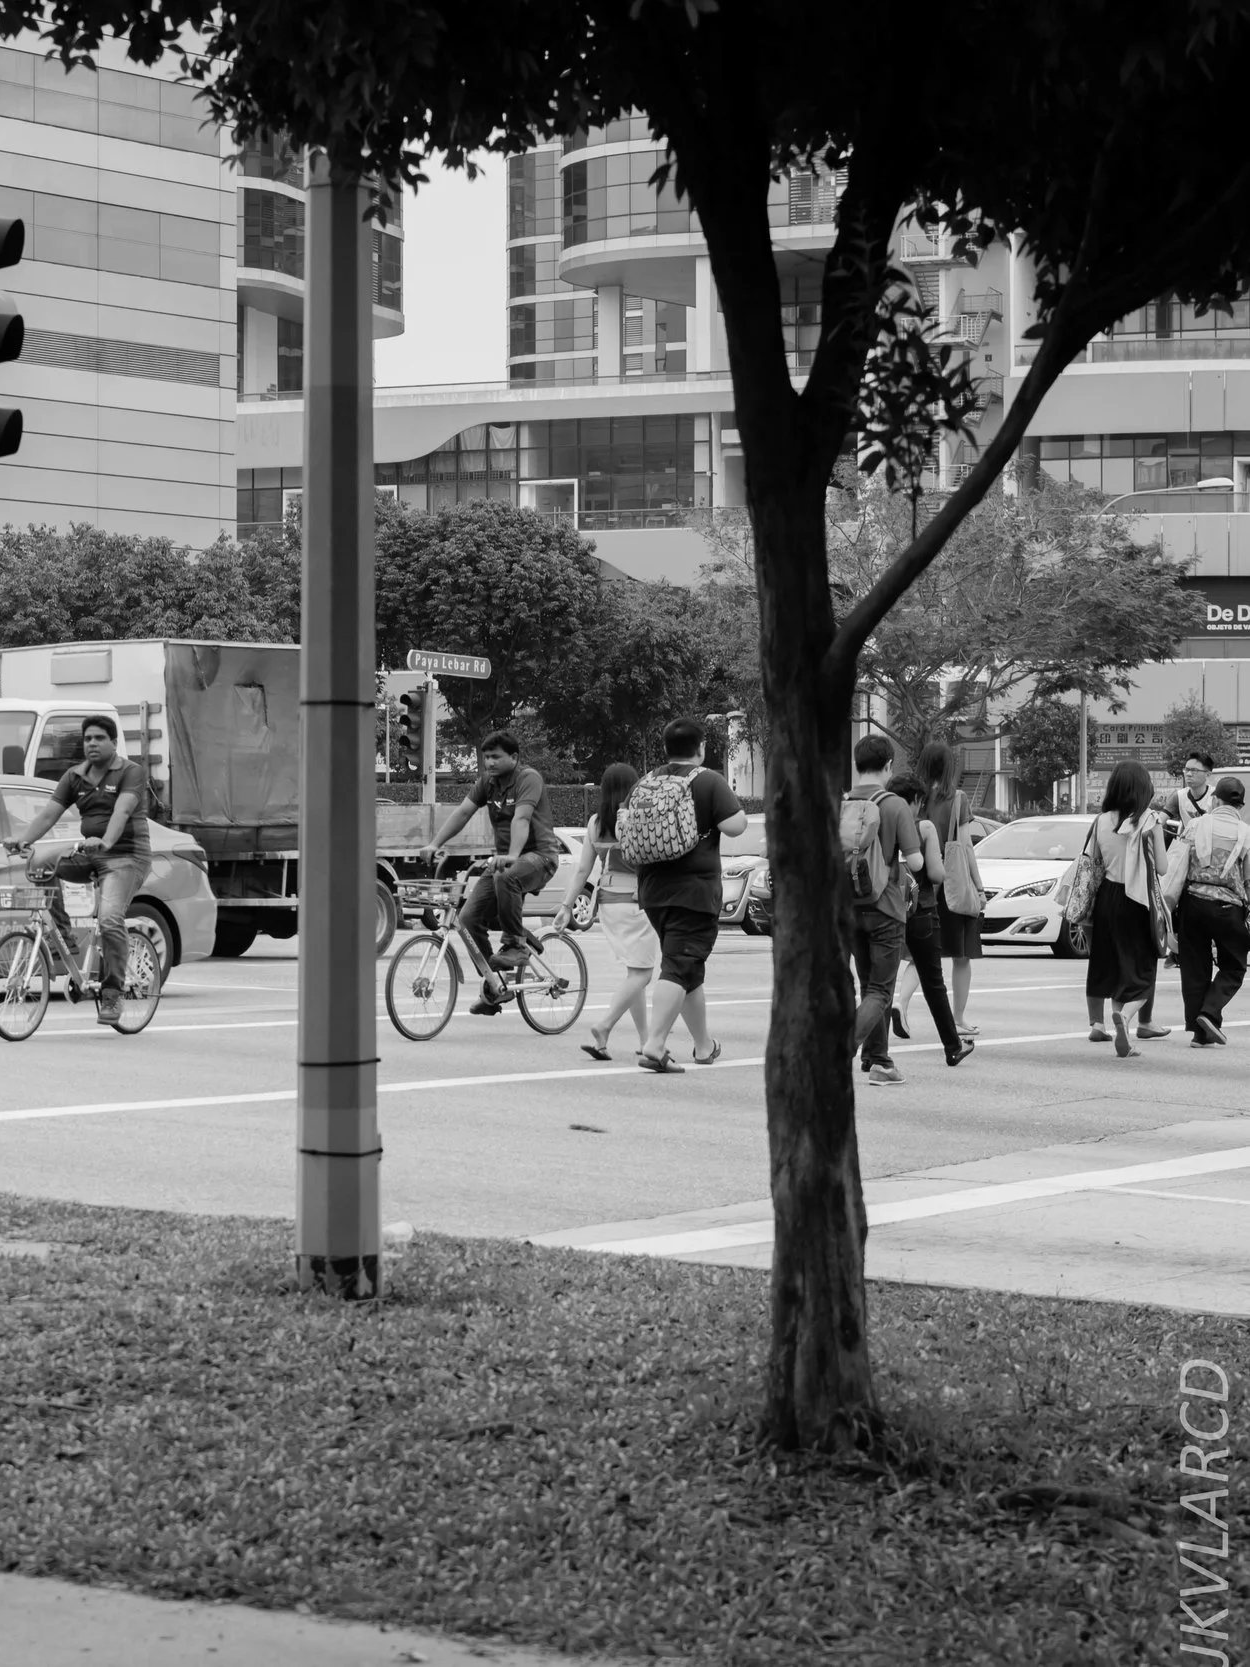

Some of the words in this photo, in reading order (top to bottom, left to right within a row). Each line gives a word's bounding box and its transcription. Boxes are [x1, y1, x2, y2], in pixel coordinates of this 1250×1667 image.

[1207, 604, 1234, 622] De
[1206, 623, 1233, 631] OBJETS
[1233, 623, 1243, 631] DE
[415, 652, 439, 670] Paya
[442, 655, 471, 672] Lebar
[473, 659, 486, 673] Rd
[1102, 724, 1126, 732] Card
[1128, 724, 1164, 733] Printing
